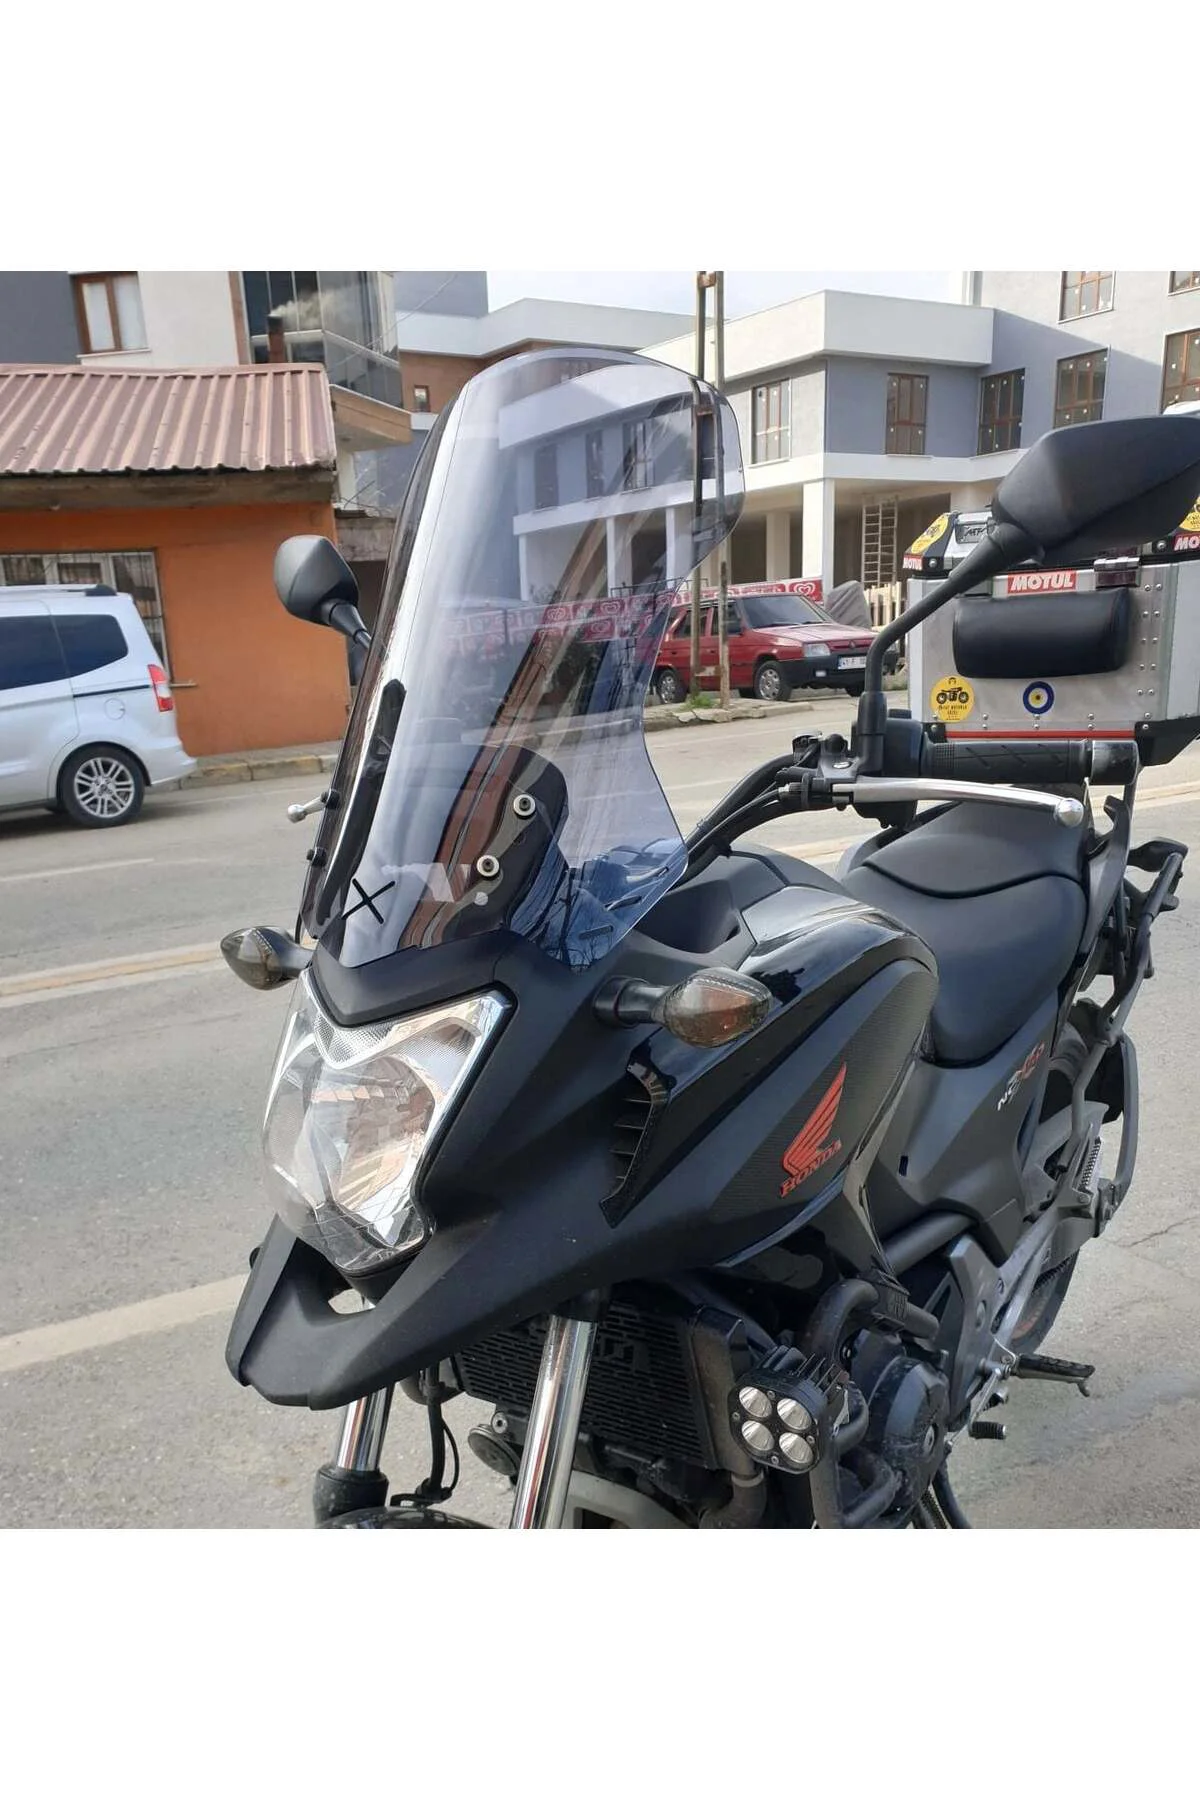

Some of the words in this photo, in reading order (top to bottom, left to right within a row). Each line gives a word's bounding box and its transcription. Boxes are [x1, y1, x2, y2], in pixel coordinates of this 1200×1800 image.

[1174, 534, 1200, 552] MO
[1010, 571, 1074, 591] MOTUL
[780, 1139, 842, 1198] HONDA
